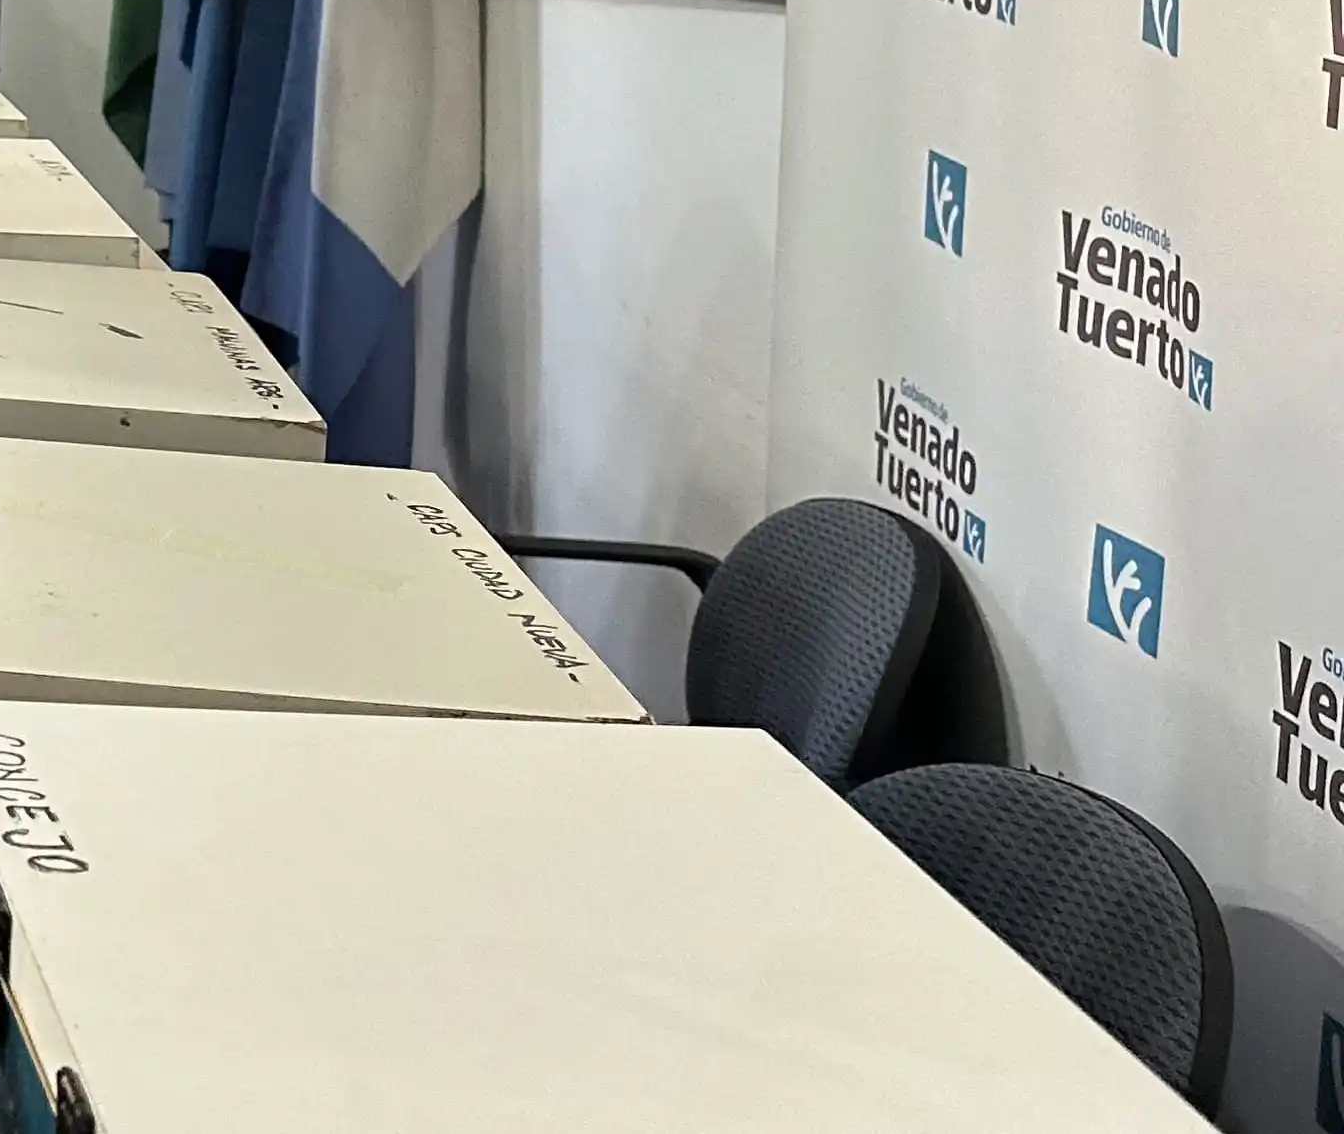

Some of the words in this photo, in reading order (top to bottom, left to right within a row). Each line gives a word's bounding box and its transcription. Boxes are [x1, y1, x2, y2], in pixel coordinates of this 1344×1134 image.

[1062, 210, 1200, 332] Venado
[1102, 206, 1159, 246] Gobierno
[1057, 272, 1184, 389] Tuerto
[875, 432, 959, 541] Tuerto
[878, 379, 976, 494] Venado
[452, 548, 523, 600] CIUDAD
